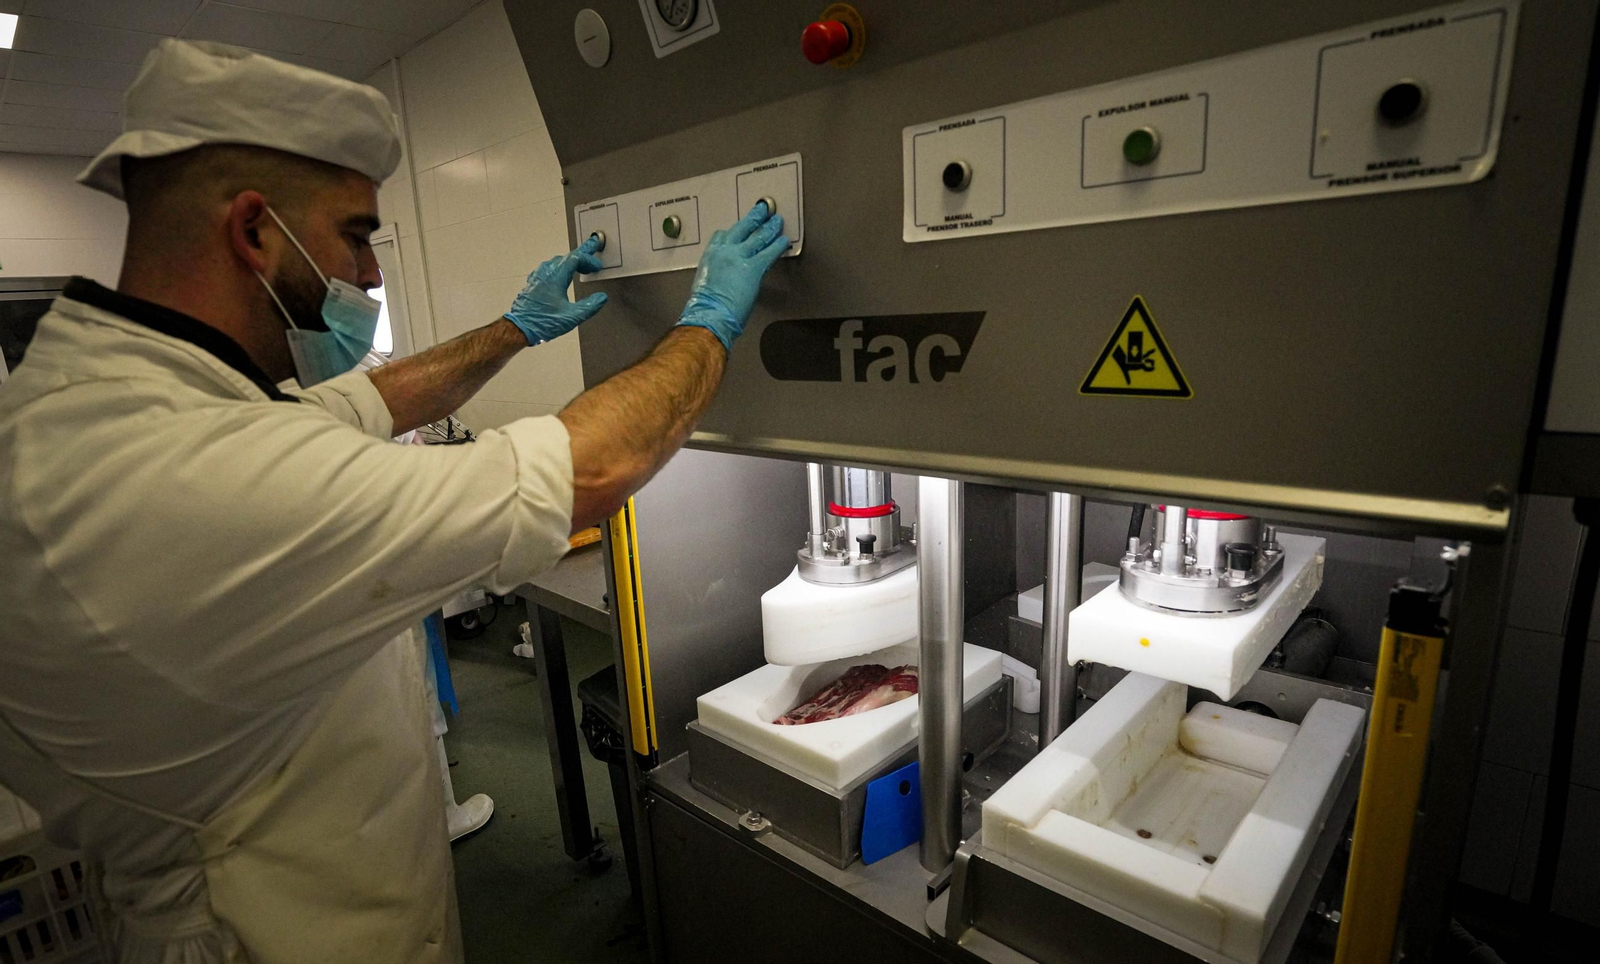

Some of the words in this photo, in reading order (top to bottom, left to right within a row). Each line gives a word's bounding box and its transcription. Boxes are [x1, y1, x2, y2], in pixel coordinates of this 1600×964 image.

[1370, 17, 1446, 40] PRENSADA
[1098, 101, 1147, 118] EXPULSOR
[1149, 93, 1190, 108] MANUAL
[938, 118, 976, 132] PRENSADA
[1366, 158, 1421, 172] MANUAL
[1328, 173, 1388, 187] PRENSOR
[1391, 164, 1462, 181] SUPERIOR
[927, 223, 959, 233] PRENSOR
[960, 219, 993, 230] TRASERO
[944, 212, 973, 222] MANUAL
[834, 319, 962, 384] fac
